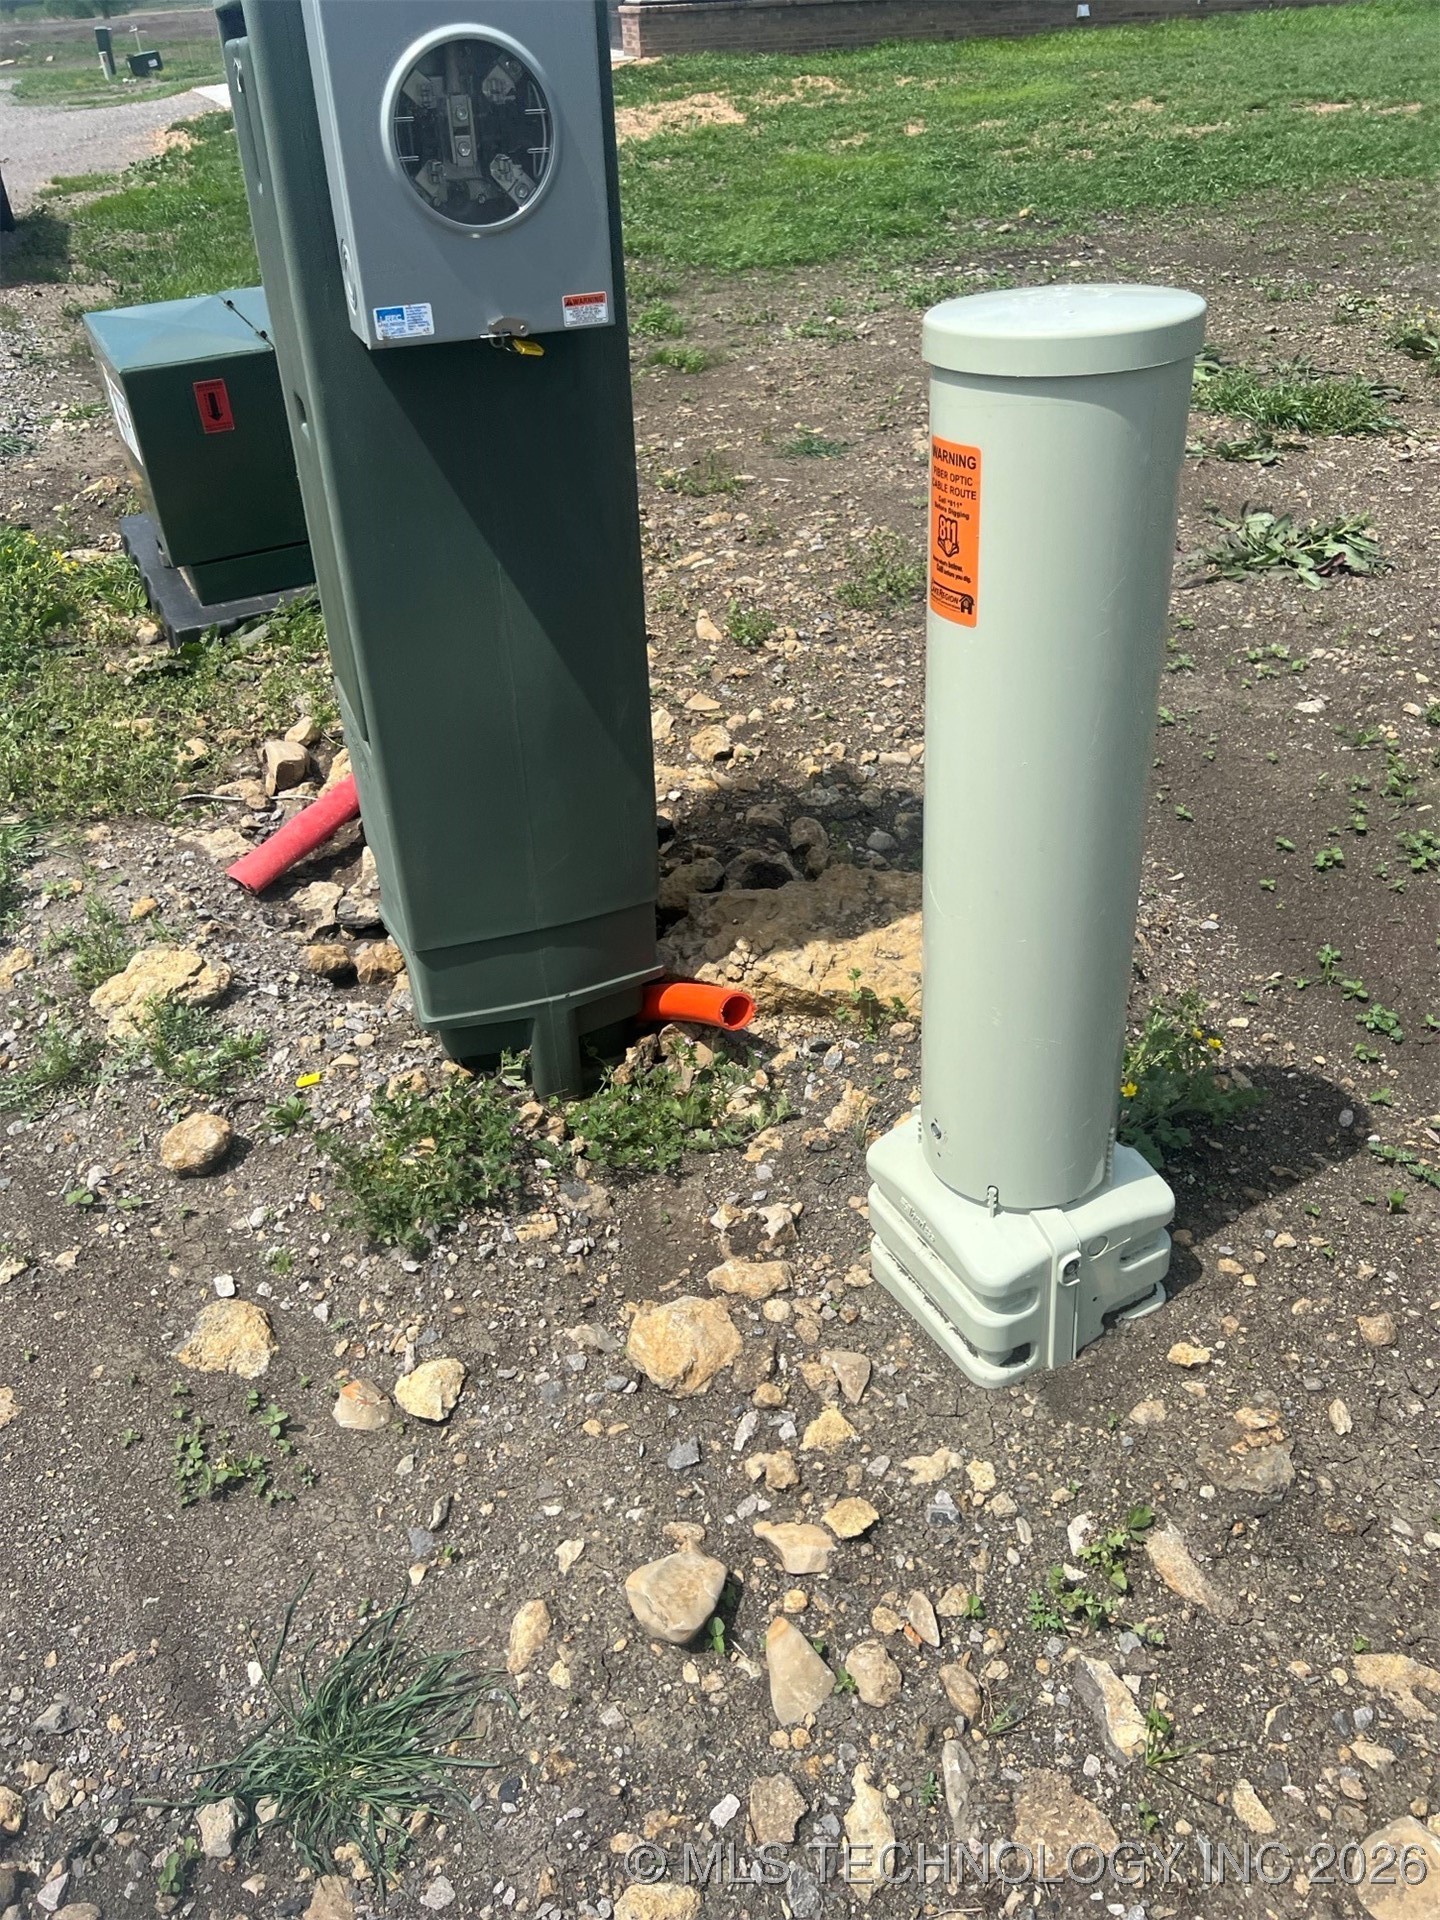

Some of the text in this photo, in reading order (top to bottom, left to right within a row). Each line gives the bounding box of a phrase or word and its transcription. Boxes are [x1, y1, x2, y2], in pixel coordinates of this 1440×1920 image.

[570, 294, 604, 307] WARNING
[932, 443, 977, 470] WARNING
[933, 465, 973, 487] FIBER OPTIC
[932, 476, 977, 501] CABLE ROUTE
[938, 495, 947, 504] Call
[934, 500, 970, 521] Before Digging
[939, 514, 959, 546] 811
